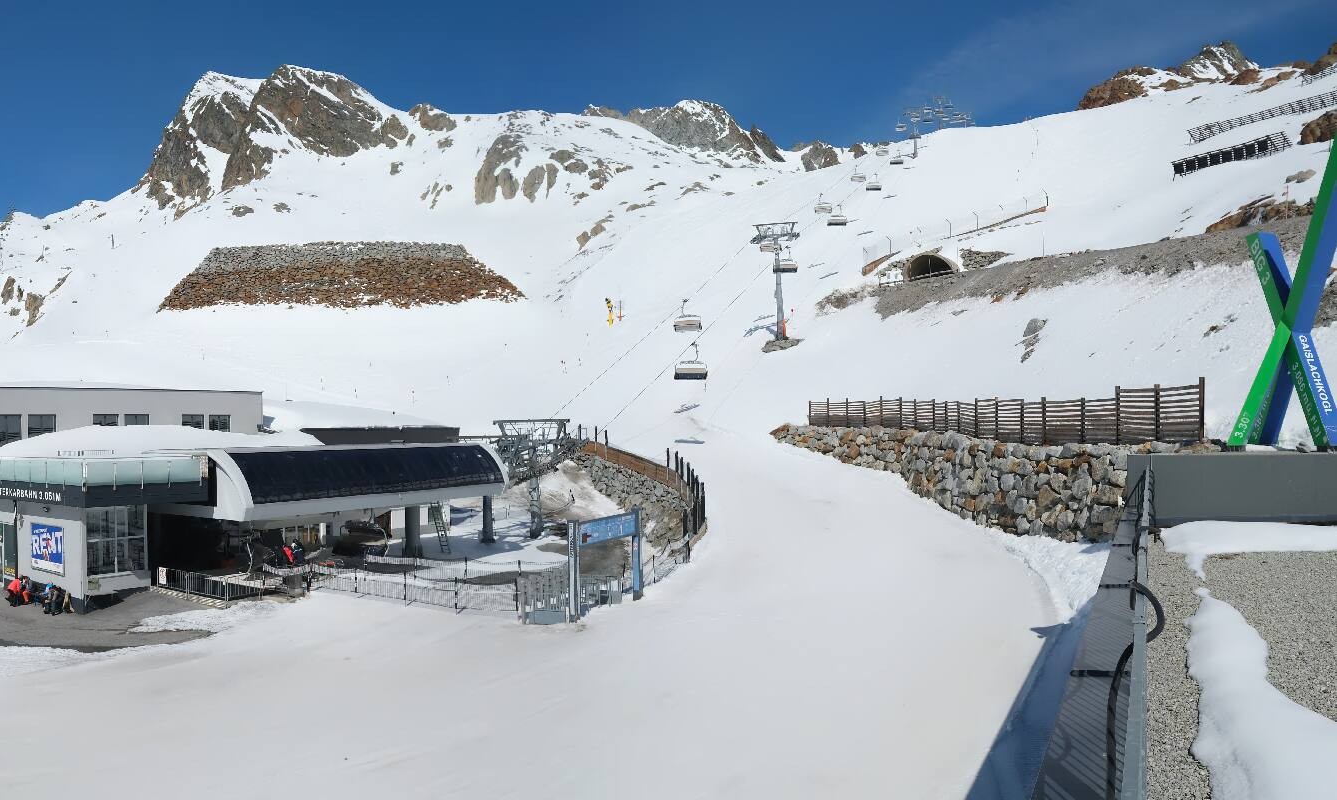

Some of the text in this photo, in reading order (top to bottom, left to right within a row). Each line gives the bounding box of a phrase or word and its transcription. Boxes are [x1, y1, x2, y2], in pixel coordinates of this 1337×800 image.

[1250, 238, 1270, 285] BIG 3
[1298, 335, 1333, 415] GAISLACHKOGL
[31, 532, 63, 555] RENT
